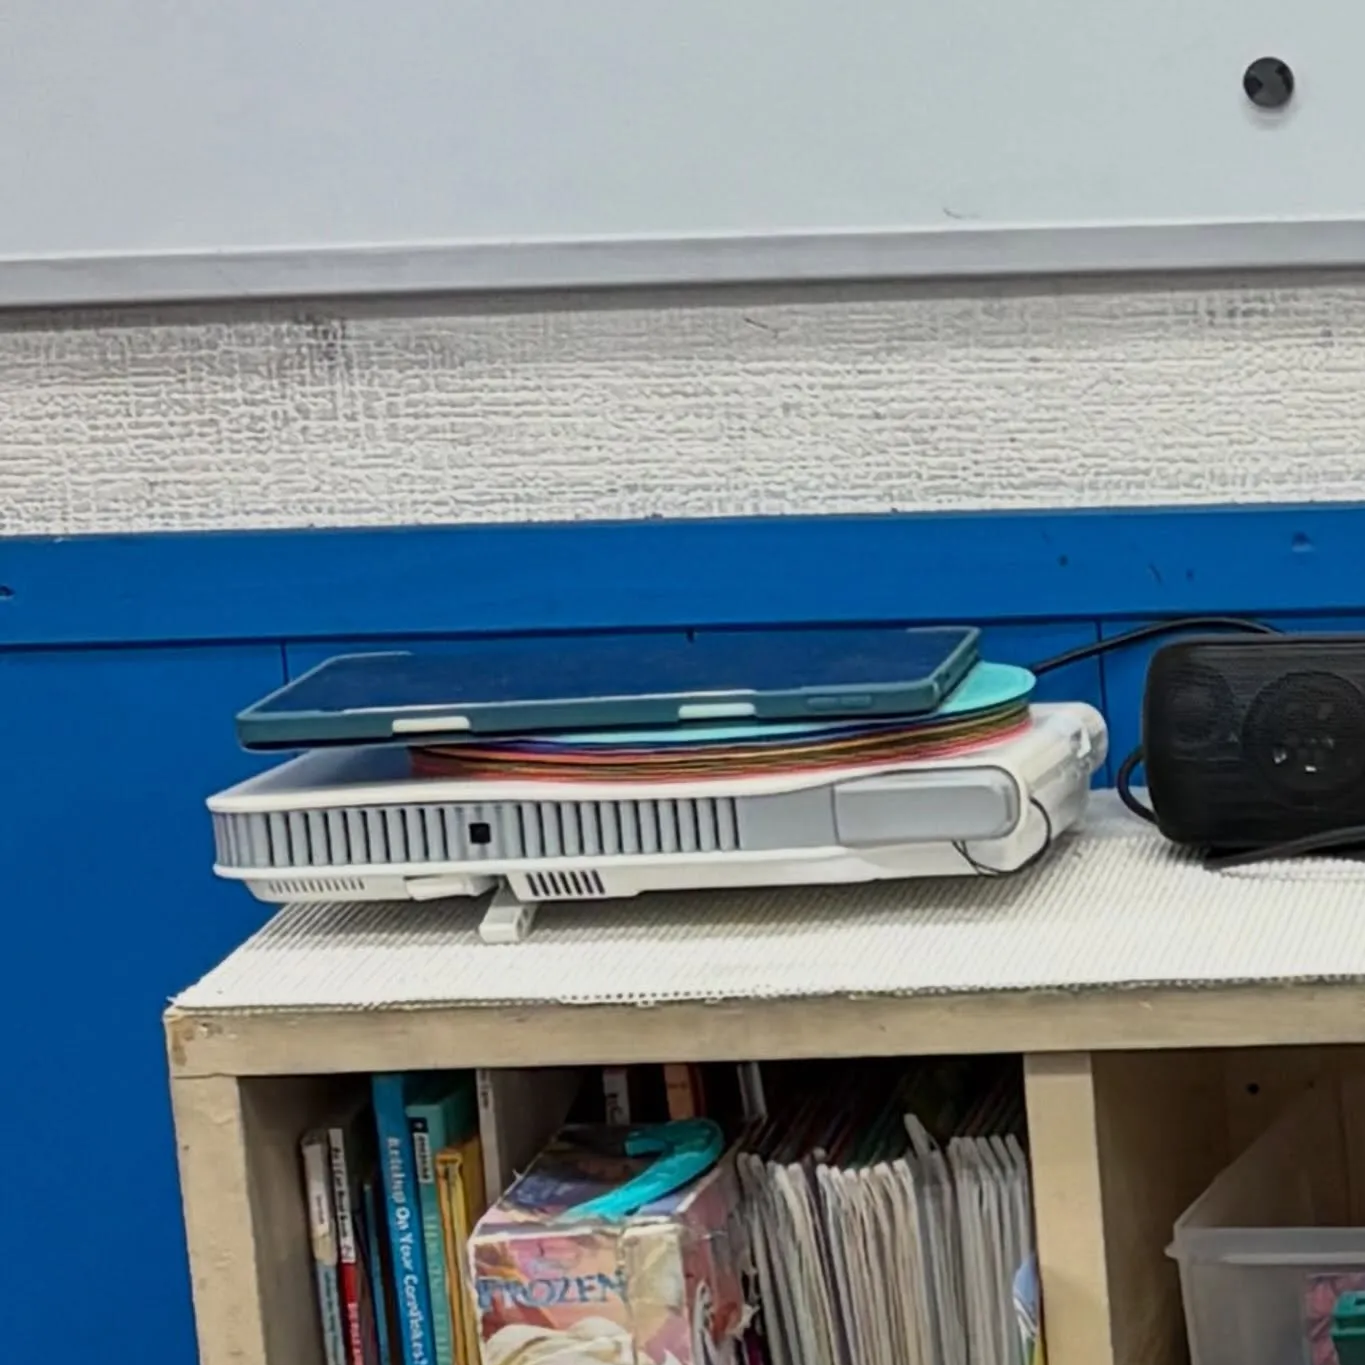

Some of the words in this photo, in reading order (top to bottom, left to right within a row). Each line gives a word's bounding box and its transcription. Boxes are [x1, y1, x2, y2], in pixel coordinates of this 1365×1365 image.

[395, 1206, 411, 1231] On
[399, 1231, 415, 1271] Your
[475, 1267, 629, 1309] FROZEN
